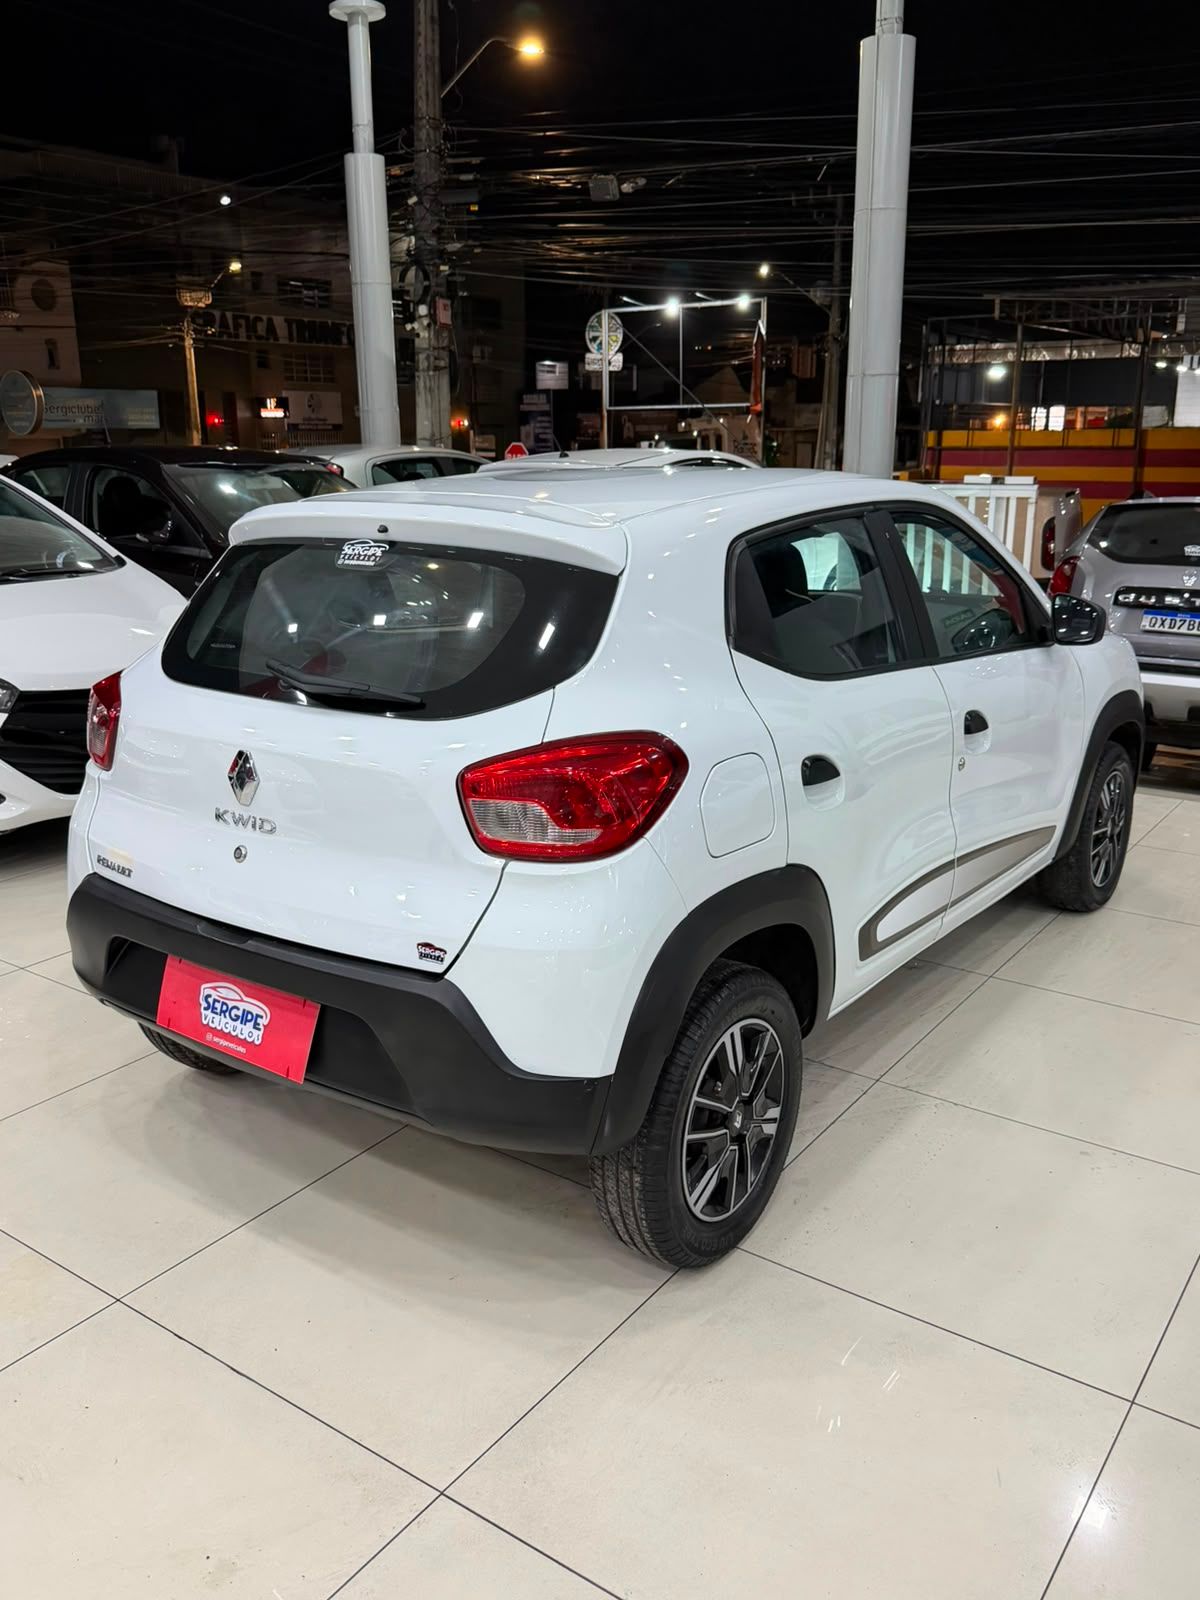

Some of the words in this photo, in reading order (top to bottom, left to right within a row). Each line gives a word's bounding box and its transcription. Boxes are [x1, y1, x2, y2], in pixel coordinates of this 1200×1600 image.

[342, 544, 386, 556] SERGIPE
[214, 807, 277, 834] KWID
[203, 994, 263, 1031] SERGIPE
